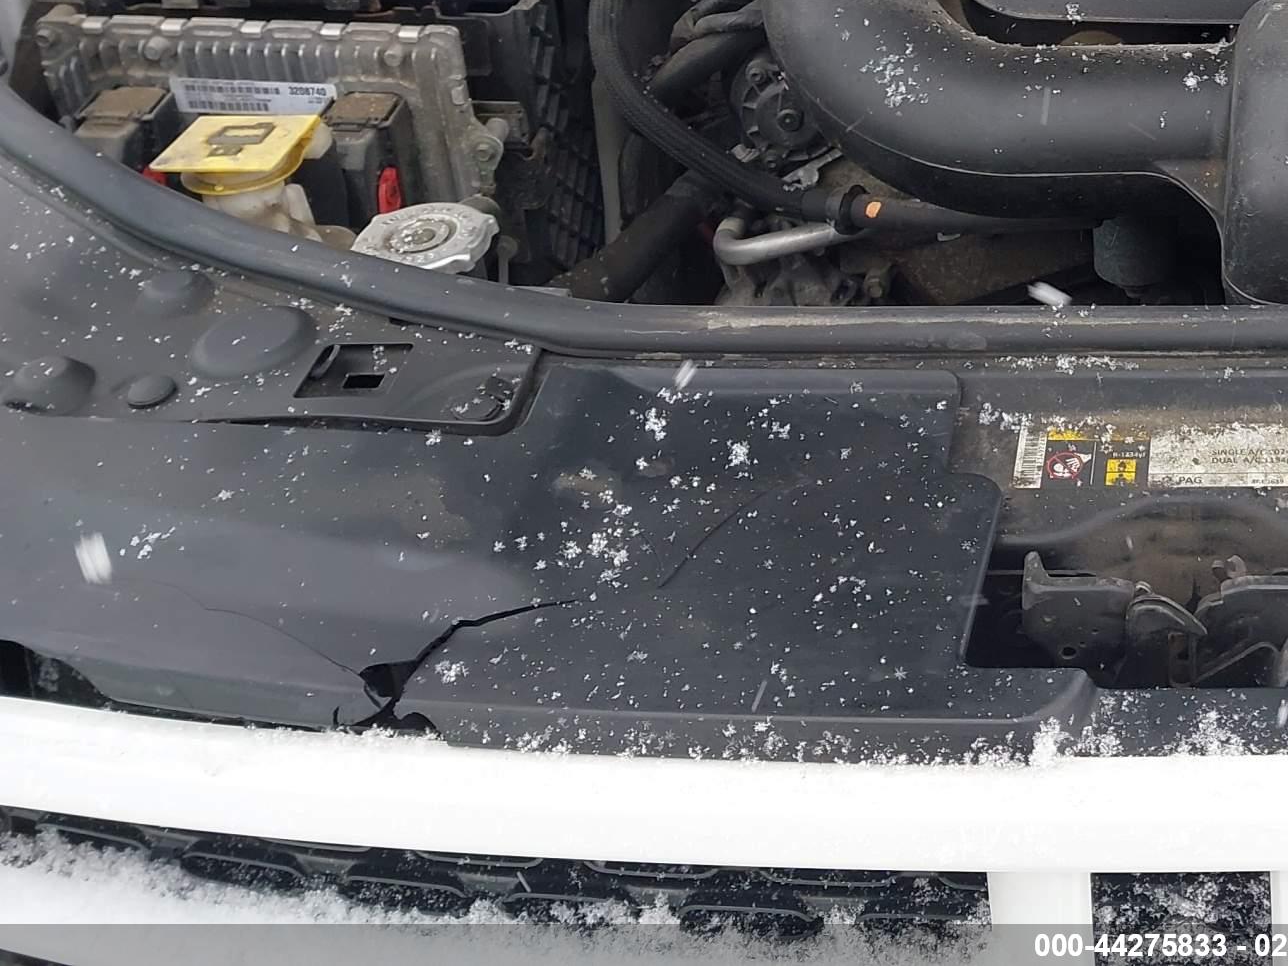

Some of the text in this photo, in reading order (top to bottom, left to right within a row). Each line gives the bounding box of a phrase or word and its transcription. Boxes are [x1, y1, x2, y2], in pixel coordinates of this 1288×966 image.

[1211, 448, 1246, 456] SINGLE
[1211, 456, 1238, 464] DUAL
[1178, 476, 1203, 484] PAG
